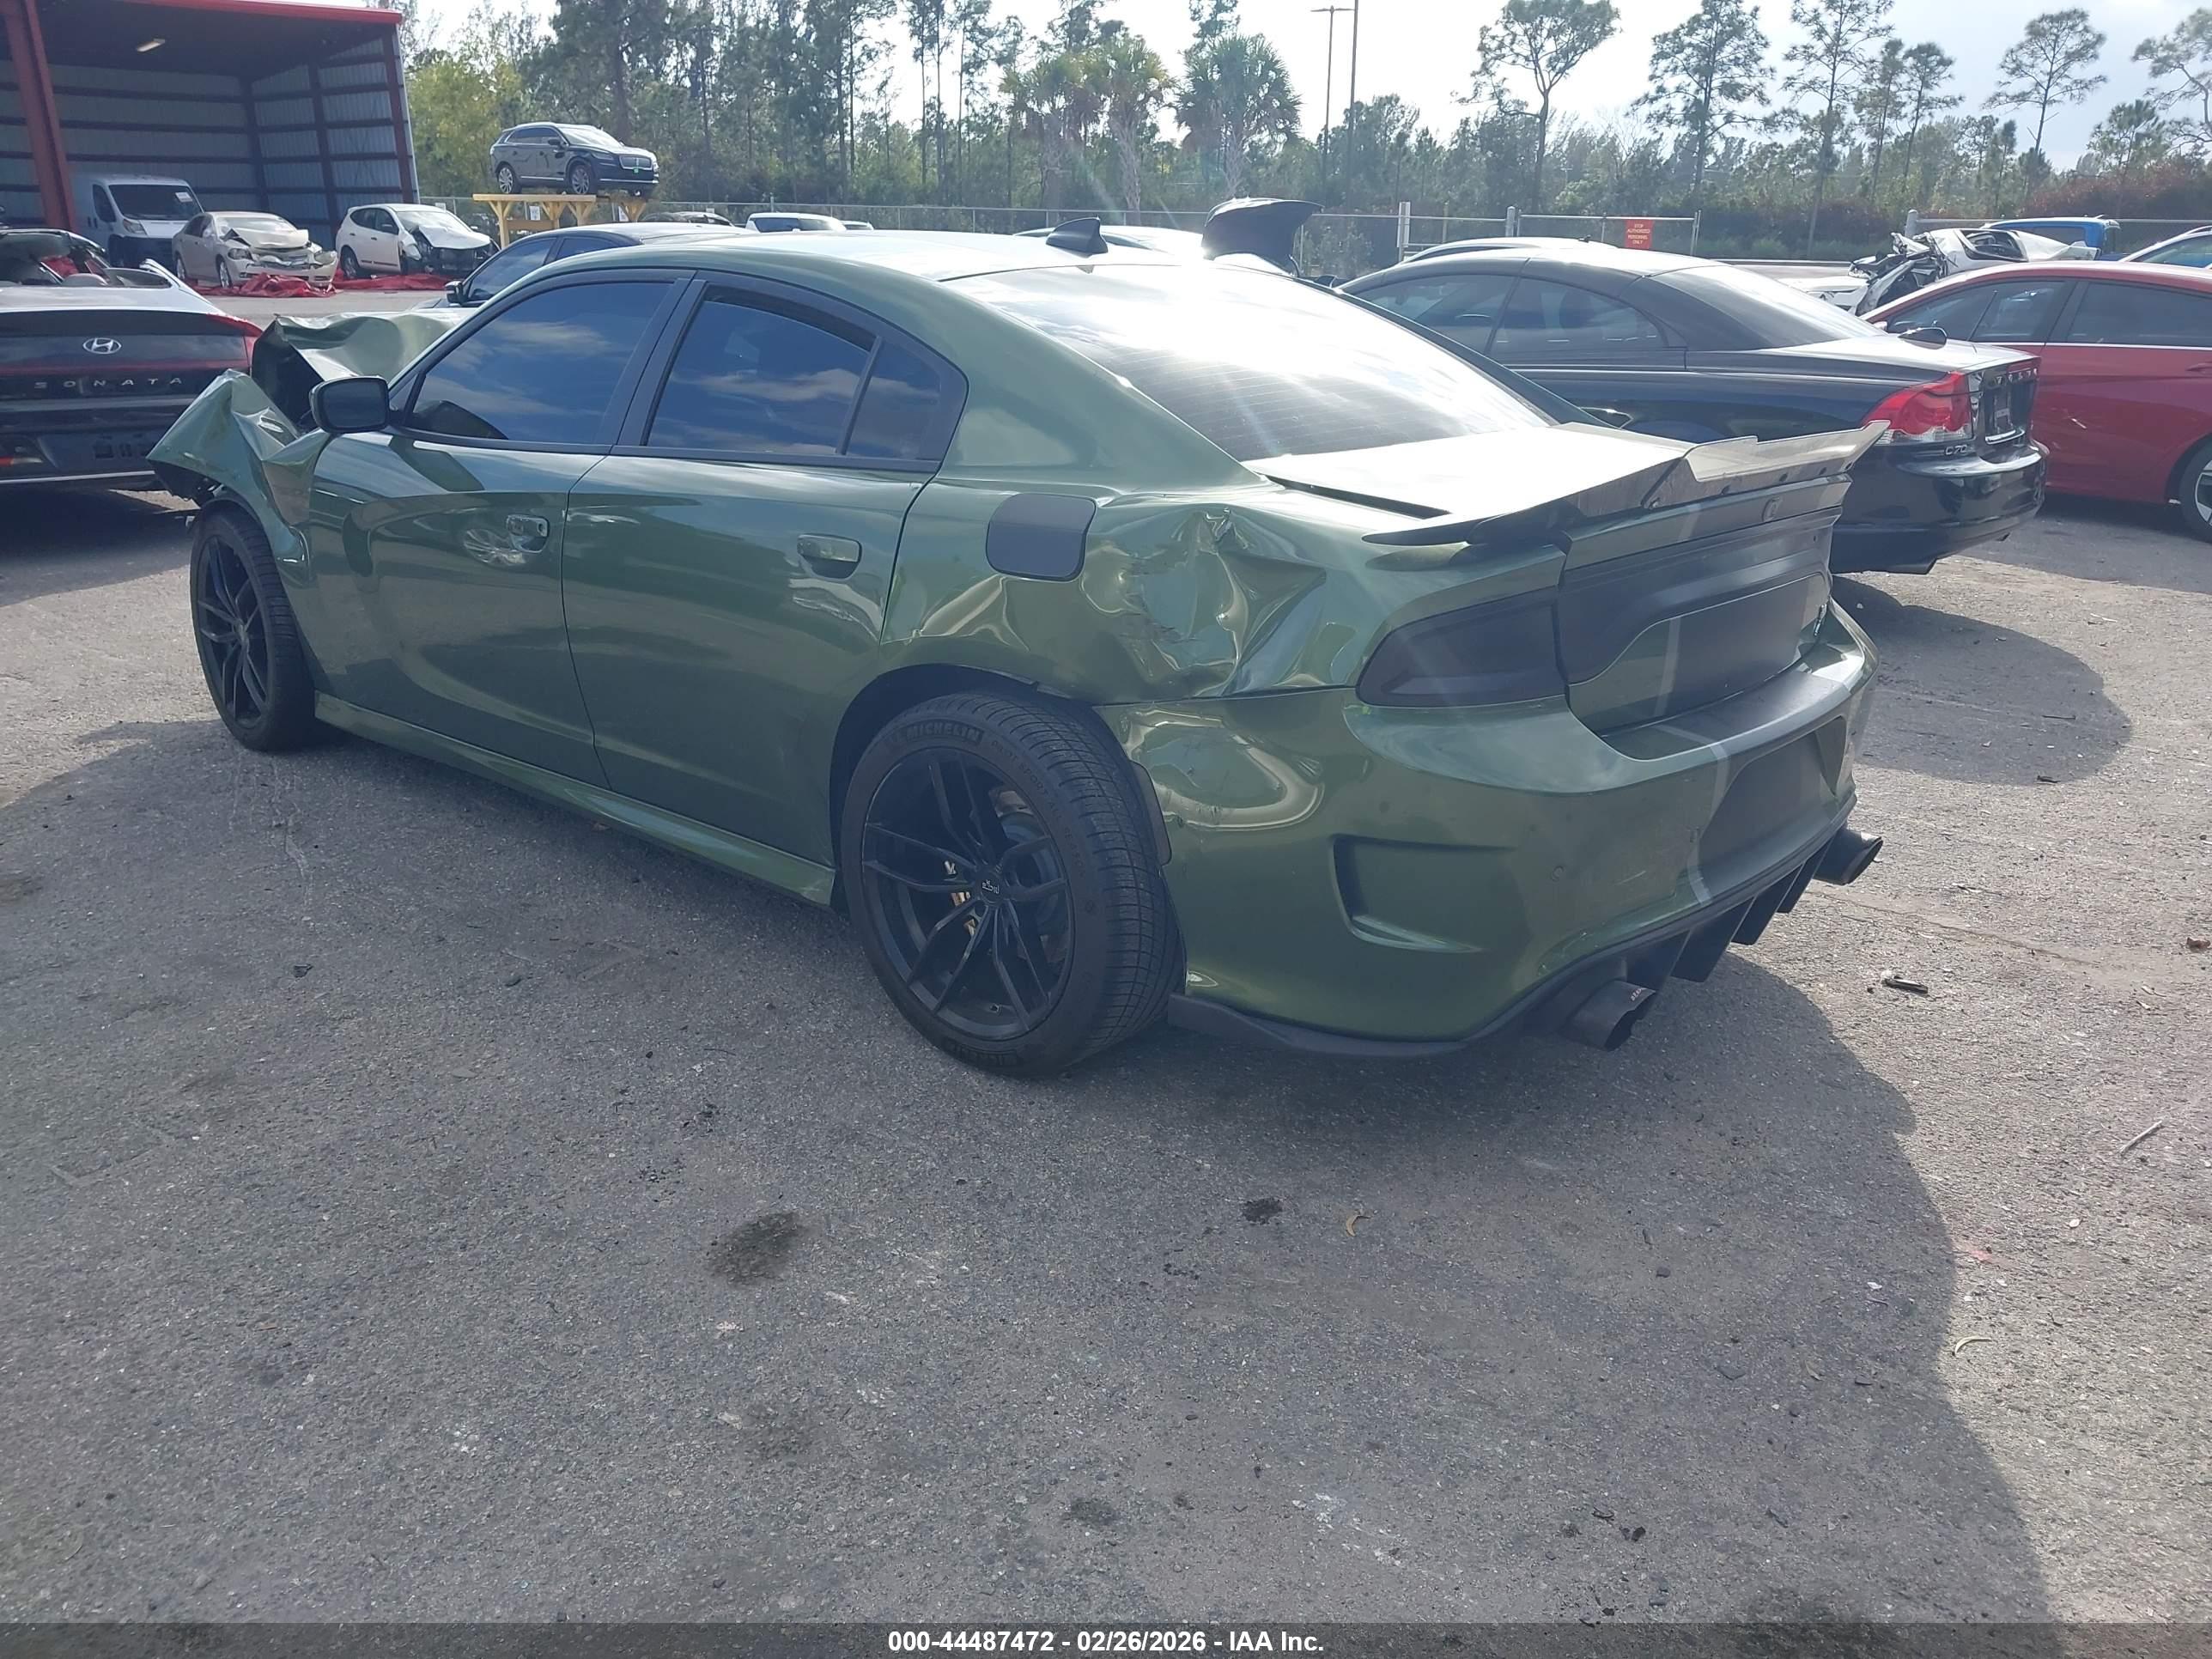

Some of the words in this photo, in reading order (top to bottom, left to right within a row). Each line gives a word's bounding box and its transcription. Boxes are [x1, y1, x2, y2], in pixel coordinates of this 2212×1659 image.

[33, 377, 183, 389] SONATA
[1944, 445, 1968, 456] C70
[906, 721, 981, 743] MICHELIN
